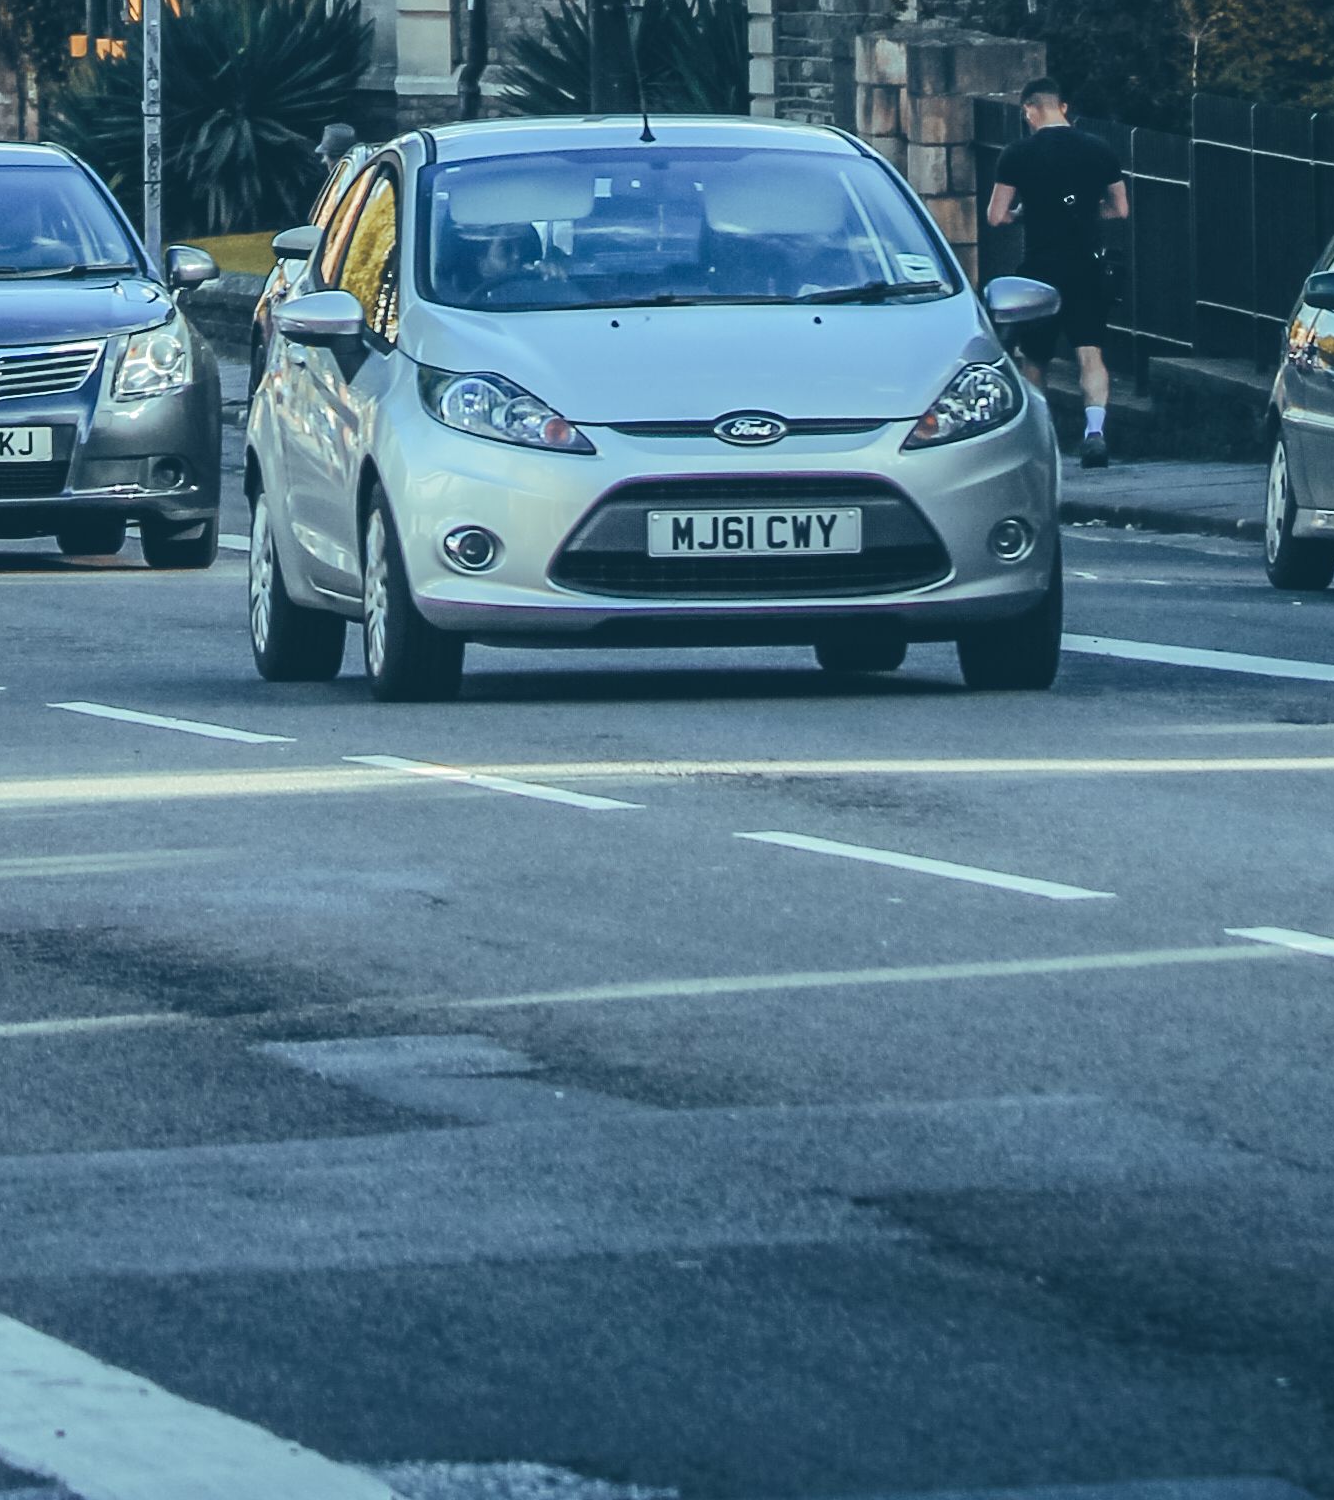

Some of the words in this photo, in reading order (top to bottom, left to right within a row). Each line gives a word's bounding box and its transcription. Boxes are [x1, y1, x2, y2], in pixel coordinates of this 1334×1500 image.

[730, 418, 772, 436] Ford
[672, 515, 754, 550] MJ61
[766, 514, 837, 549] CWY
